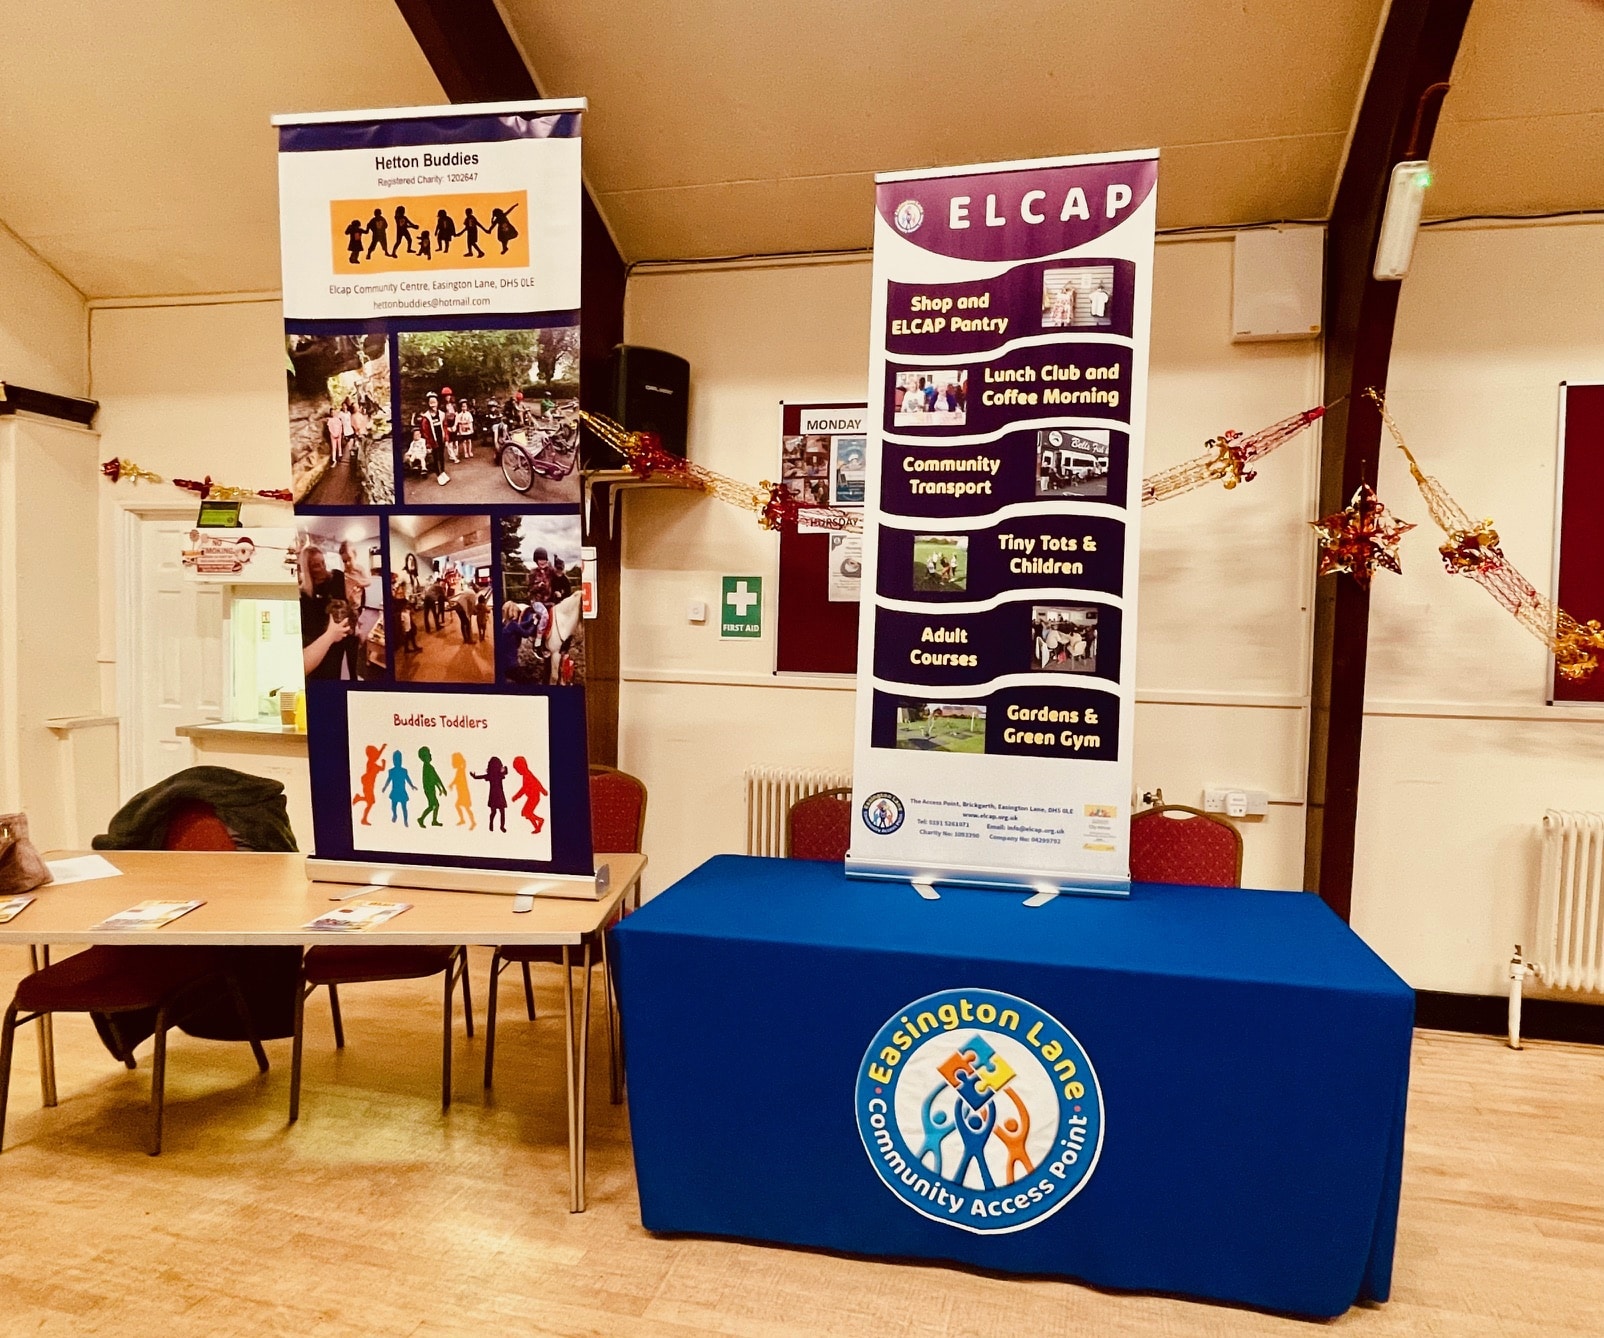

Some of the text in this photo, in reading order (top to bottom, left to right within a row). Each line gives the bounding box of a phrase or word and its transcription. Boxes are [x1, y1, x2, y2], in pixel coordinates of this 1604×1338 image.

[375, 152, 479, 170] Hetton Buddies
[377, 172, 479, 187] Registered Charity: 1202647
[949, 184, 1132, 229] ELCAP
[329, 284, 352, 296] Elcap
[354, 282, 398, 295] Community
[400, 280, 430, 292] Centre,
[432, 279, 473, 292] Easington
[474, 278, 497, 290] Lane,
[499, 278, 519, 289] DH5
[373, 296, 491, 310] hettonbuddies@hotmail.com
[911, 293, 990, 313] Shop and
[891, 317, 1009, 335] ELCAP Pantry
[984, 363, 1120, 383] Lunch Club and
[982, 386, 1120, 407] Coffee Morning
[806, 419, 862, 430] MONDAY
[903, 456, 1001, 475] Community
[909, 479, 992, 498] Transport
[998, 535, 1097, 553] Tiny Tots &
[1010, 558, 1083, 575] Children
[921, 627, 968, 644] Adult
[910, 649, 978, 667] Courses
[393, 714, 488, 729] Buddies Toddlers
[1007, 705, 1098, 725] Gardens &
[1004, 728, 1100, 751] Green Gym
[998, 804, 1028, 812] Easington
[989, 834, 1018, 842] Company
[868, 999, 1085, 1101] Easington Lane
[868, 1098, 1089, 1218] Community Access Point
